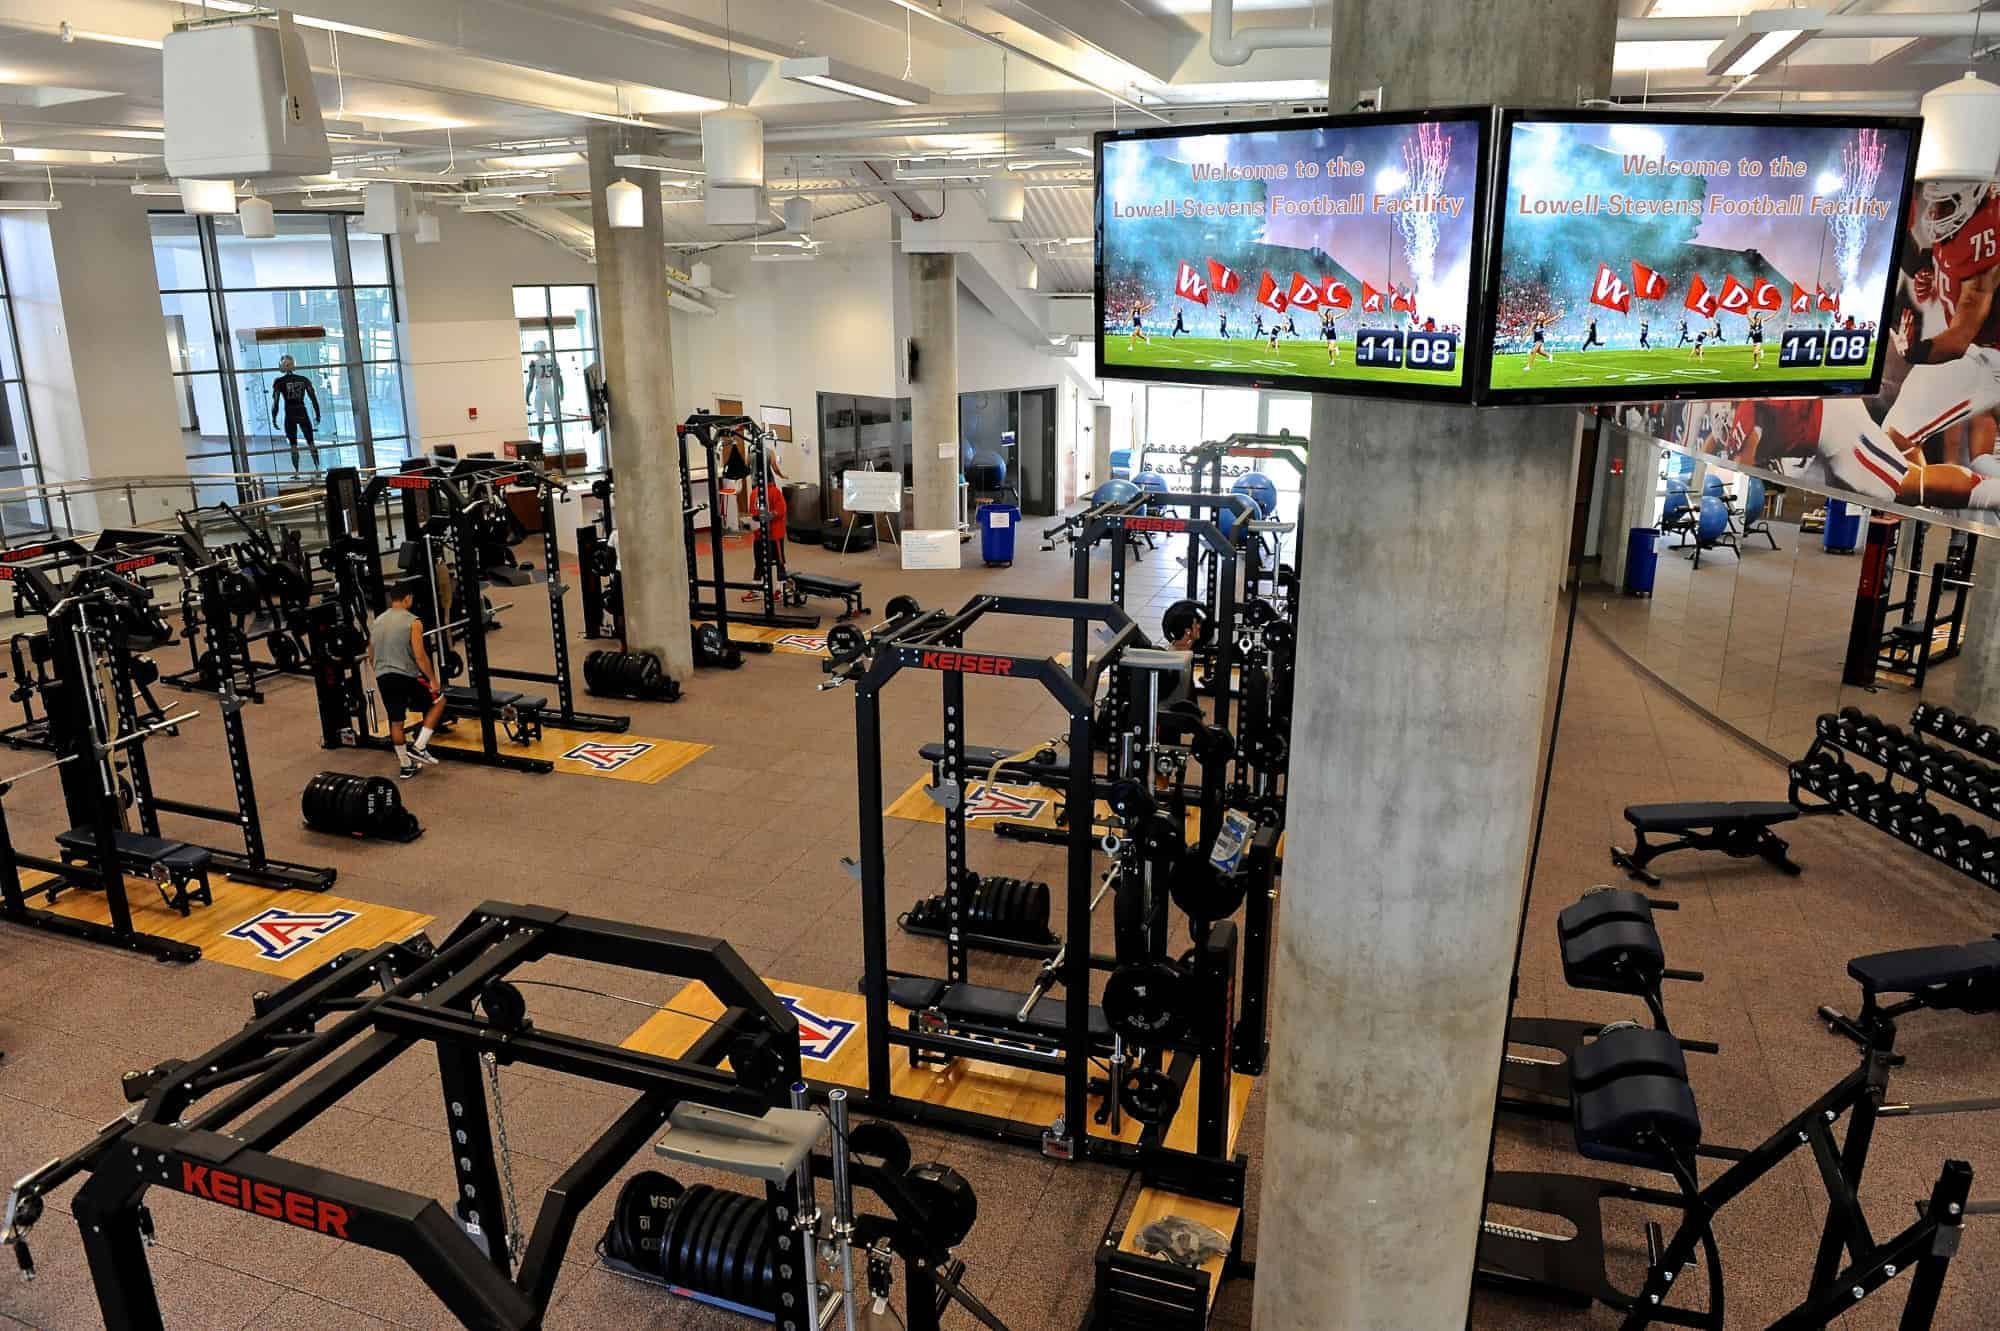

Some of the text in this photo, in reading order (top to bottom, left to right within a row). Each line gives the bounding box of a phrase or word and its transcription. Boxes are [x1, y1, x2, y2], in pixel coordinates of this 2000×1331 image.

[1191, 155, 1366, 182] Welcome to the
[1623, 154, 1808, 177] Welcome to the
[1112, 191, 1464, 218] Lowell-Stevens Football Facility
[1518, 192, 1891, 221] Lowell-Stevens Football Facility
[1970, 228, 1996, 263] 75
[1411, 338, 1450, 364] 08
[1830, 336, 1866, 360] 08
[1123, 517, 1186, 532] KEISER
[114, 555, 156, 574] KEISER
[922, 651, 1014, 675] KEISER
[181, 1159, 349, 1239] KEISER
